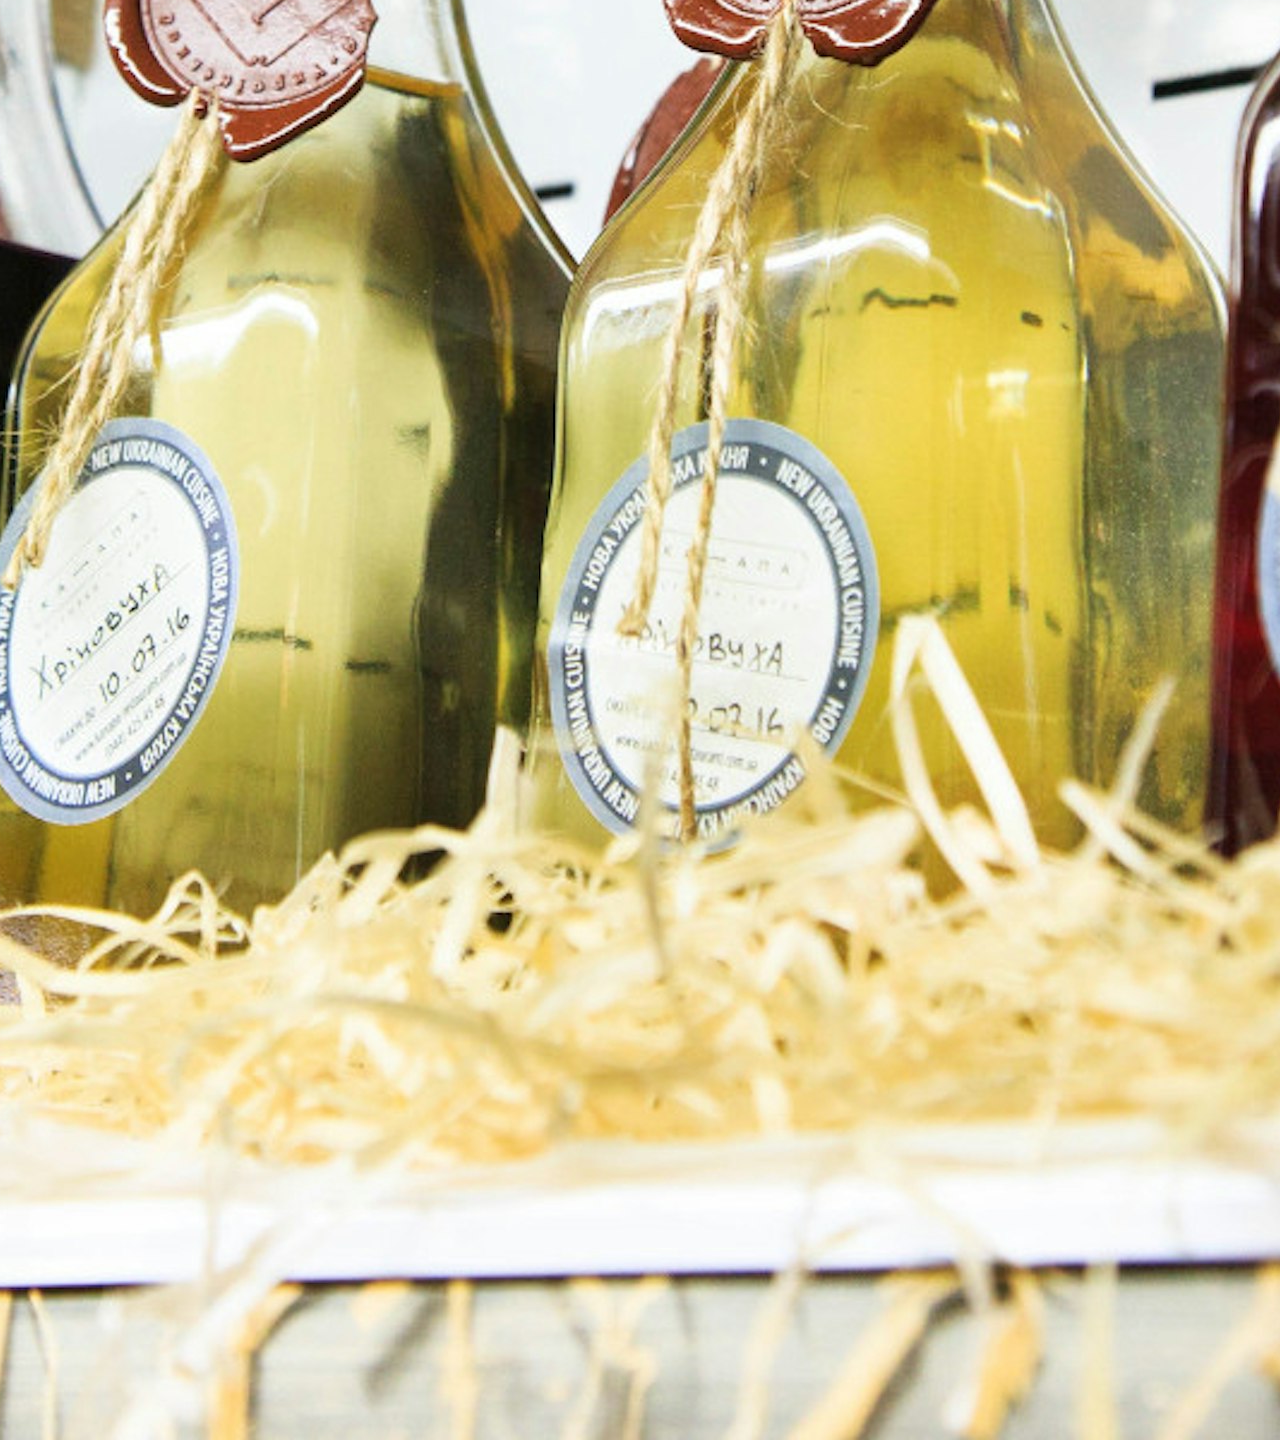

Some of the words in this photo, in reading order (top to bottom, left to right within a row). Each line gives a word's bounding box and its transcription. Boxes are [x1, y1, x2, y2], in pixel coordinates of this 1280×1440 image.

[89, 439, 122, 472] NEW
[122, 437, 189, 482] UKRAINIAN
[180, 463, 220, 531] CUISINE
[210, 545, 228, 601] НОВА
[580, 531, 619, 592] НОВА
[774, 455, 817, 500] NEW
[803, 482, 861, 589] UKRAINIAN
[835, 584, 862, 671] CUISINE
[99, 606, 191, 704] 10.07.16
[174, 604, 227, 725] УКРАЇНСЬКА
[137, 713, 183, 775] КУХНЯ
[808, 694, 844, 748] НОВ
[20, 757, 85, 805] UKRAINIAN
[83, 772, 116, 805] NEW
[601, 777, 640, 821] NEW
